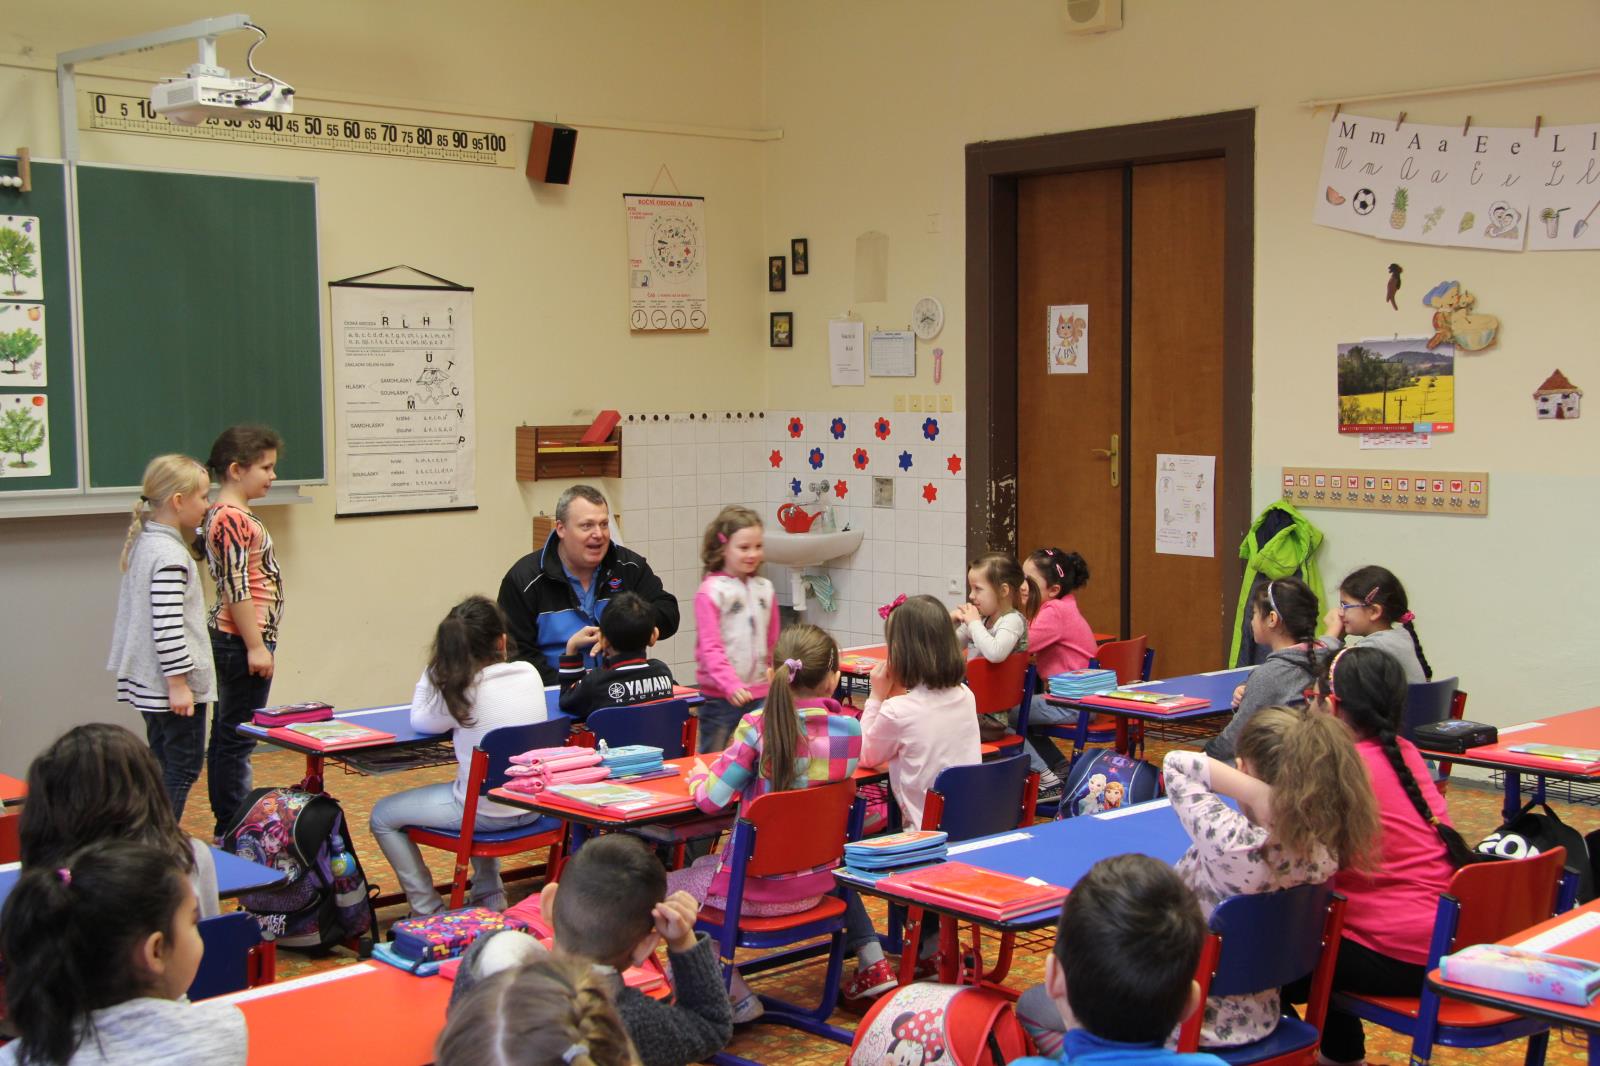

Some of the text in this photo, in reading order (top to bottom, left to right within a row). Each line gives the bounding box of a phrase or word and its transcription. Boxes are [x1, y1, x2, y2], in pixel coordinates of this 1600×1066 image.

[96, 94, 106, 114] 0
[120, 102, 128, 117] 5
[137, 99, 157, 119] 10
[265, 114, 283, 132] 40
[286, 119, 299, 133] 45
[304, 116, 322, 136] 50
[326, 123, 339, 137] 55
[343, 120, 360, 139] 60
[364, 127, 377, 140] 65
[380, 124, 397, 143] 70
[401, 131, 413, 144] 75
[416, 127, 432, 146] 80
[436, 134, 449, 147] 85
[452, 131, 468, 149] 90
[472, 138, 483, 151] 95
[483, 134, 506, 152] 100
[1338, 121, 1521, 155] M m A a E e
[1552, 134, 1566, 152] L
[1400, 156, 1419, 180] A
[1430, 169, 1448, 183] a
[1470, 160, 1483, 186] E
[1500, 173, 1521, 186] e
[1544, 160, 1565, 186] L
[382, 316, 389, 326] R
[402, 319, 409, 329] L
[423, 316, 430, 326] H
[407, 400, 416, 410] M
[457, 408, 464, 419] V
[458, 435, 466, 445] P
[625, 676, 672, 695] YAMAHA
